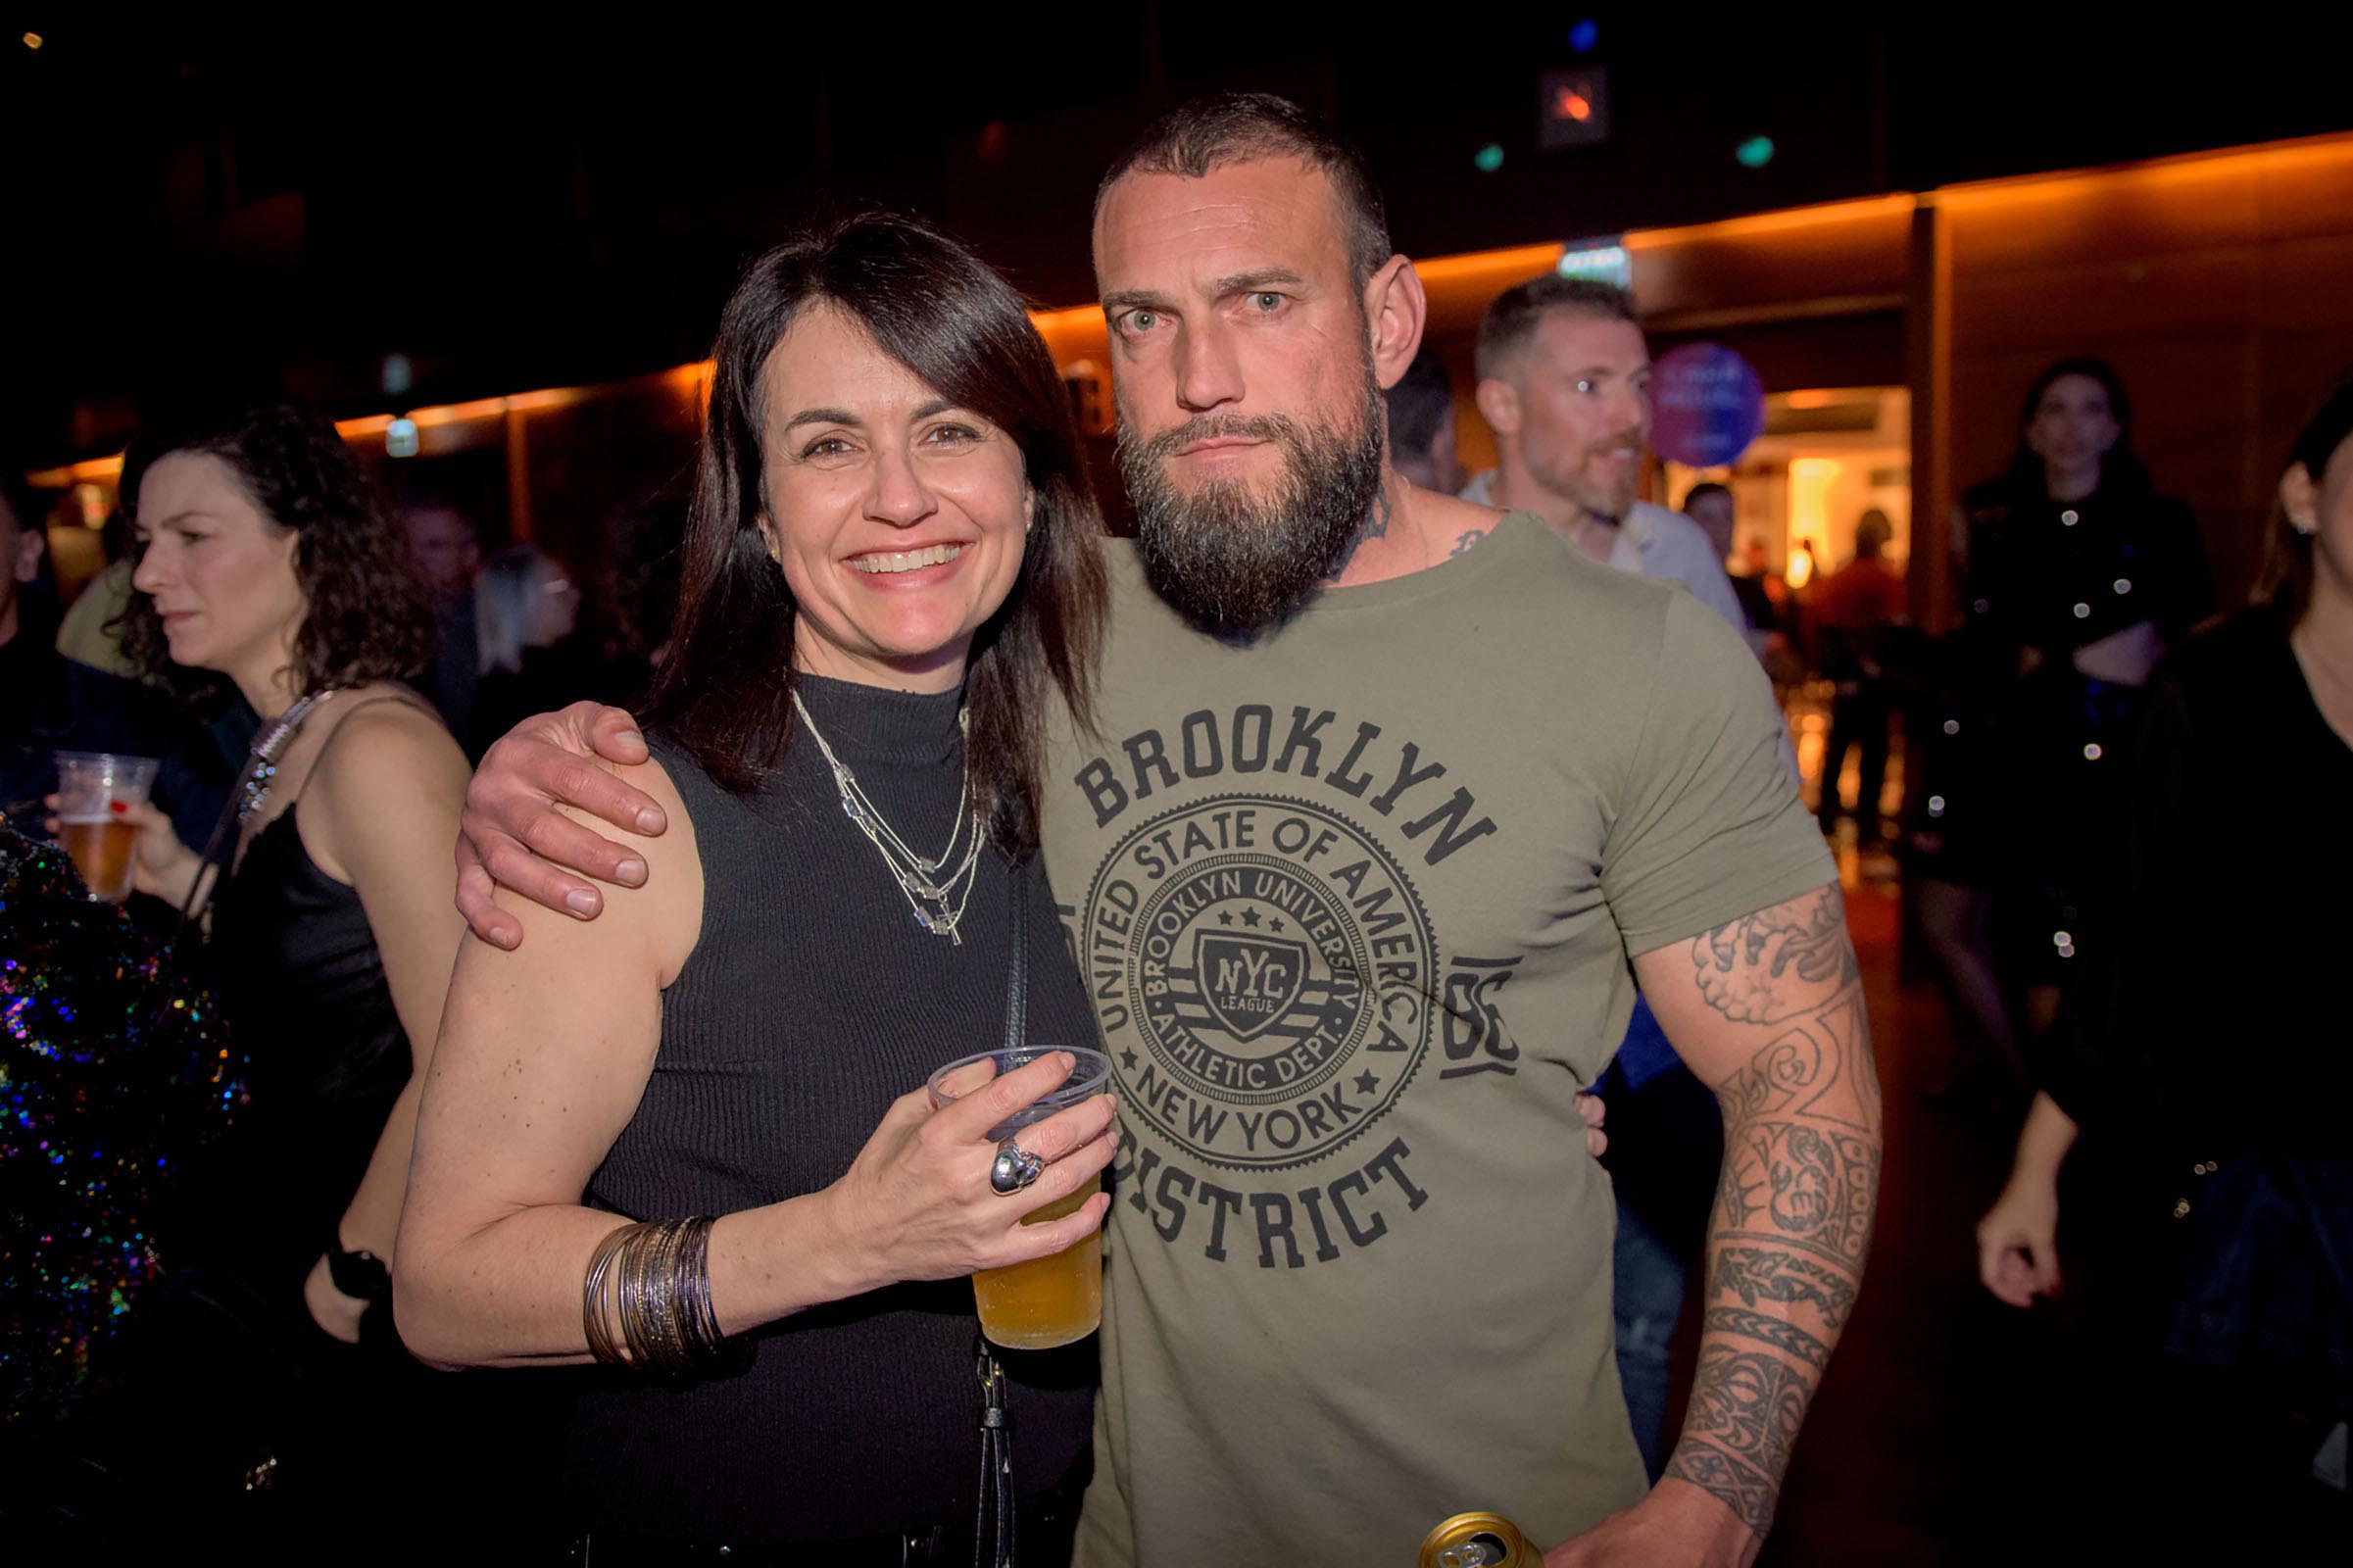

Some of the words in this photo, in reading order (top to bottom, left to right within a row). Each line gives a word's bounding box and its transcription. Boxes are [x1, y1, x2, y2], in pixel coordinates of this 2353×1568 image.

[1073, 703, 1497, 866] BROOKLYN
[1092, 879, 1139, 1033] UNITED
[1133, 809, 1256, 880] STATE
[1273, 817, 1339, 863] OF
[1329, 859, 1419, 1053] AMERICA
[1144, 869, 1242, 997] BROOKLYN
[1254, 871, 1360, 1010] UNIVERSITY
[1214, 948, 1287, 999] NYC
[1220, 995, 1275, 1014] LEAGUE
[1151, 1013, 1267, 1090] ATHLETIC
[1275, 1025, 1344, 1083] DEPT.
[1135, 1067, 1229, 1147] NEW
[1236, 1081, 1363, 1152] YORK
